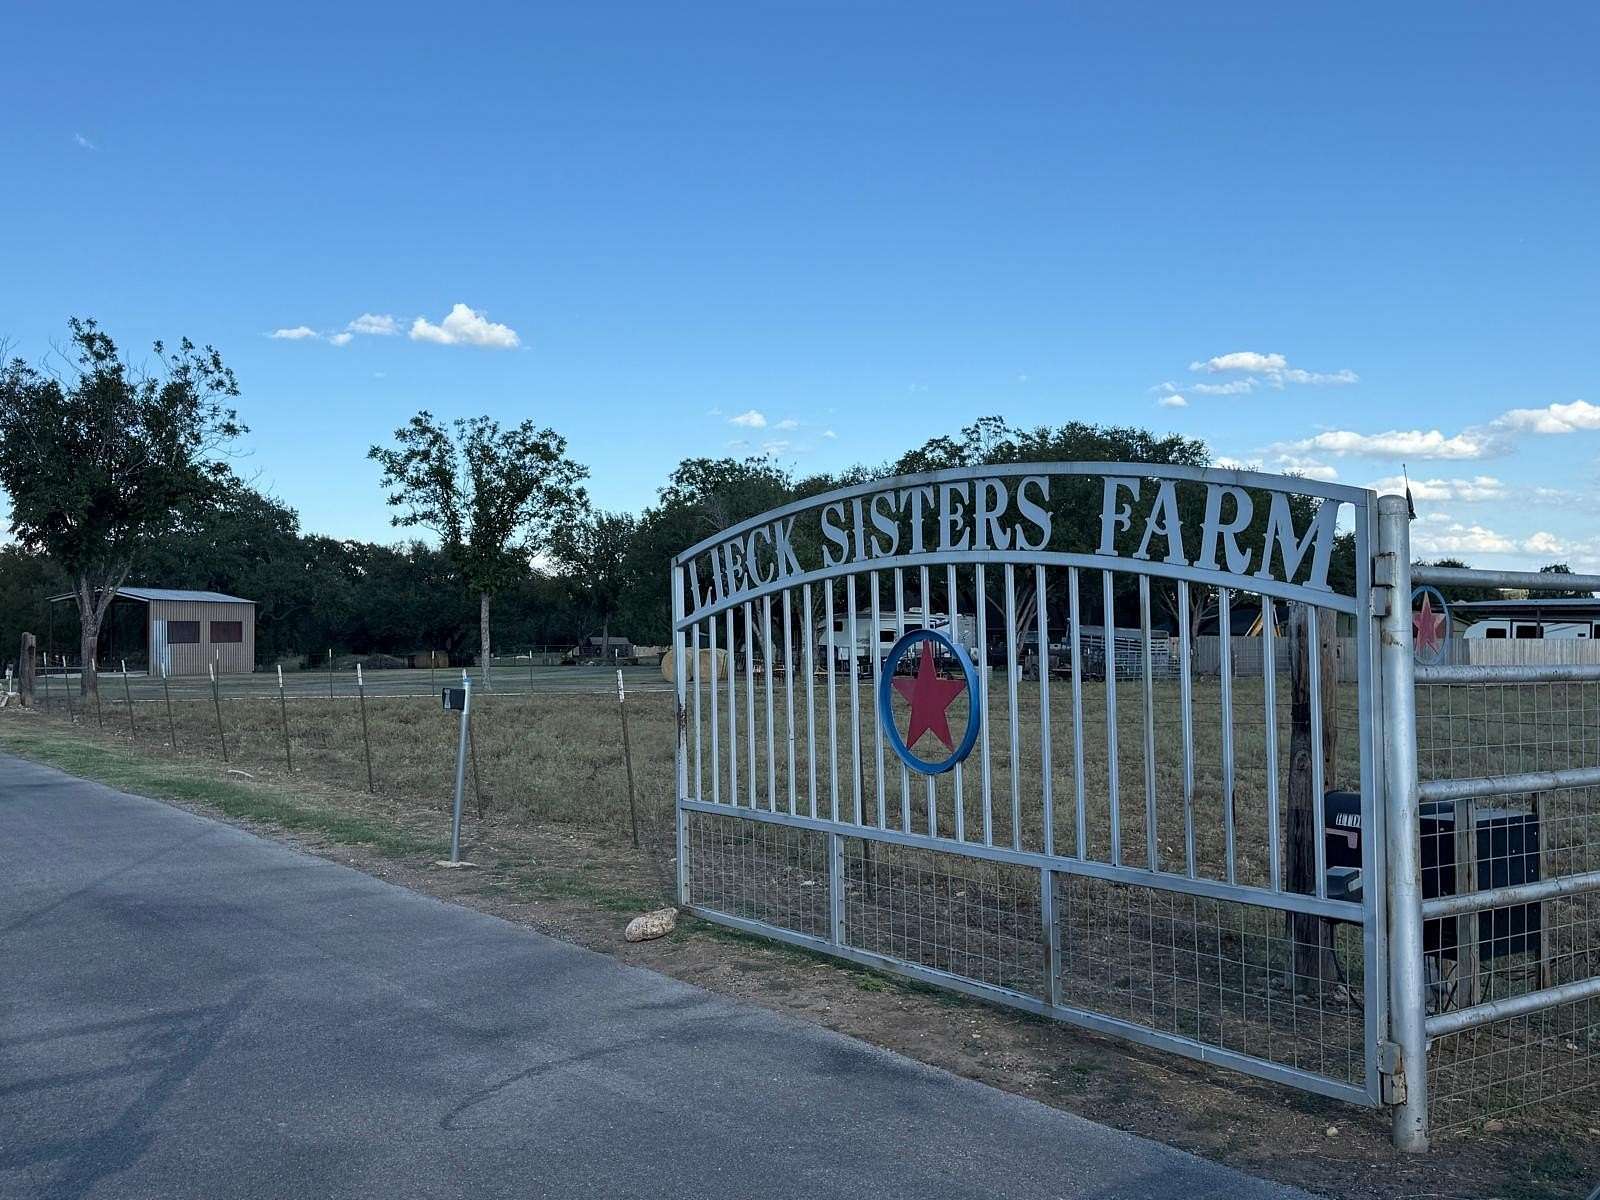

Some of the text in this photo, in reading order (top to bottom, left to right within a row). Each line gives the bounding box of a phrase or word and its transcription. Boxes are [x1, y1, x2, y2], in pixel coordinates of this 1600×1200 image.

[689, 475, 1338, 614] LIECK SISTERS FARM
